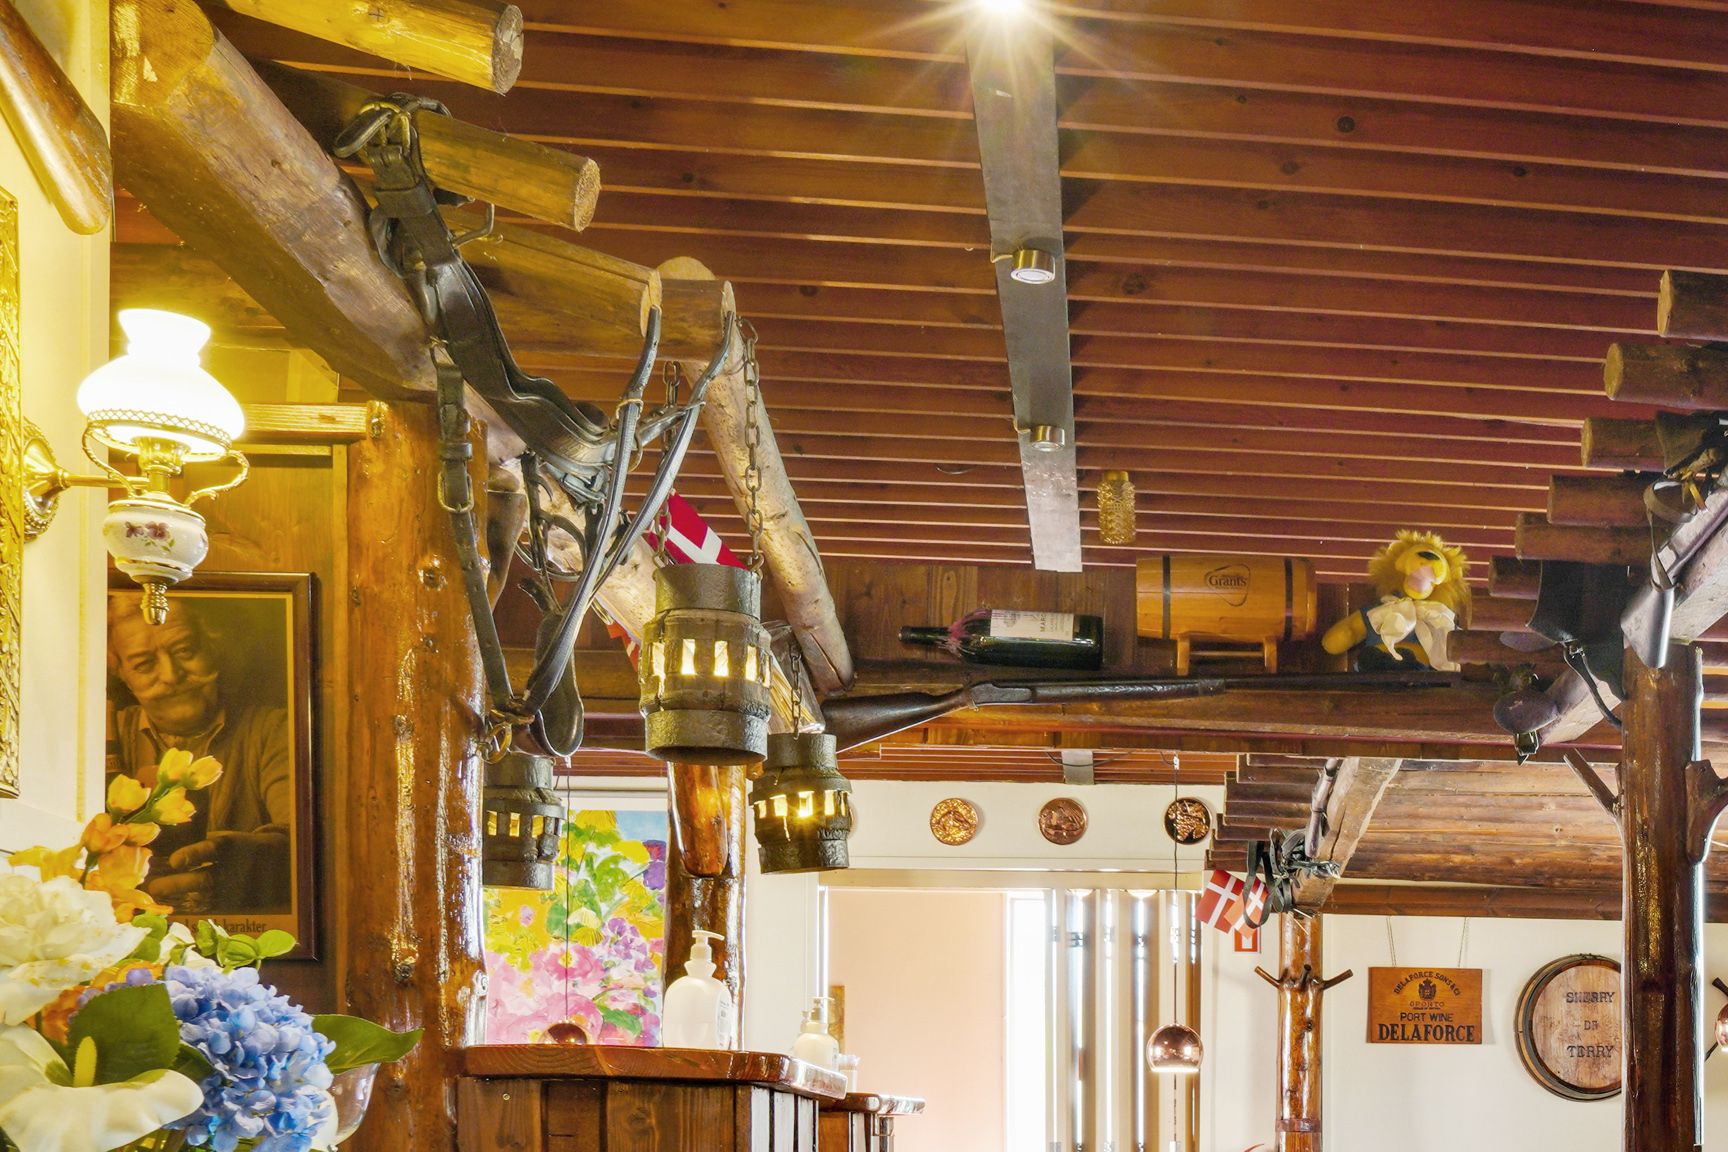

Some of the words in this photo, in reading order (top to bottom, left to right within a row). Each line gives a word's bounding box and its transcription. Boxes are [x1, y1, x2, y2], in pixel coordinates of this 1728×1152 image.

[1393, 971, 1433, 995] DELAFORCE
[1565, 991, 1616, 1004] SHERRY
[1400, 1012, 1426, 1022] PORT
[1429, 1013, 1454, 1022] WINE
[1378, 1023, 1475, 1042] DELAFORCE
[1566, 1045, 1614, 1058] TERRY
